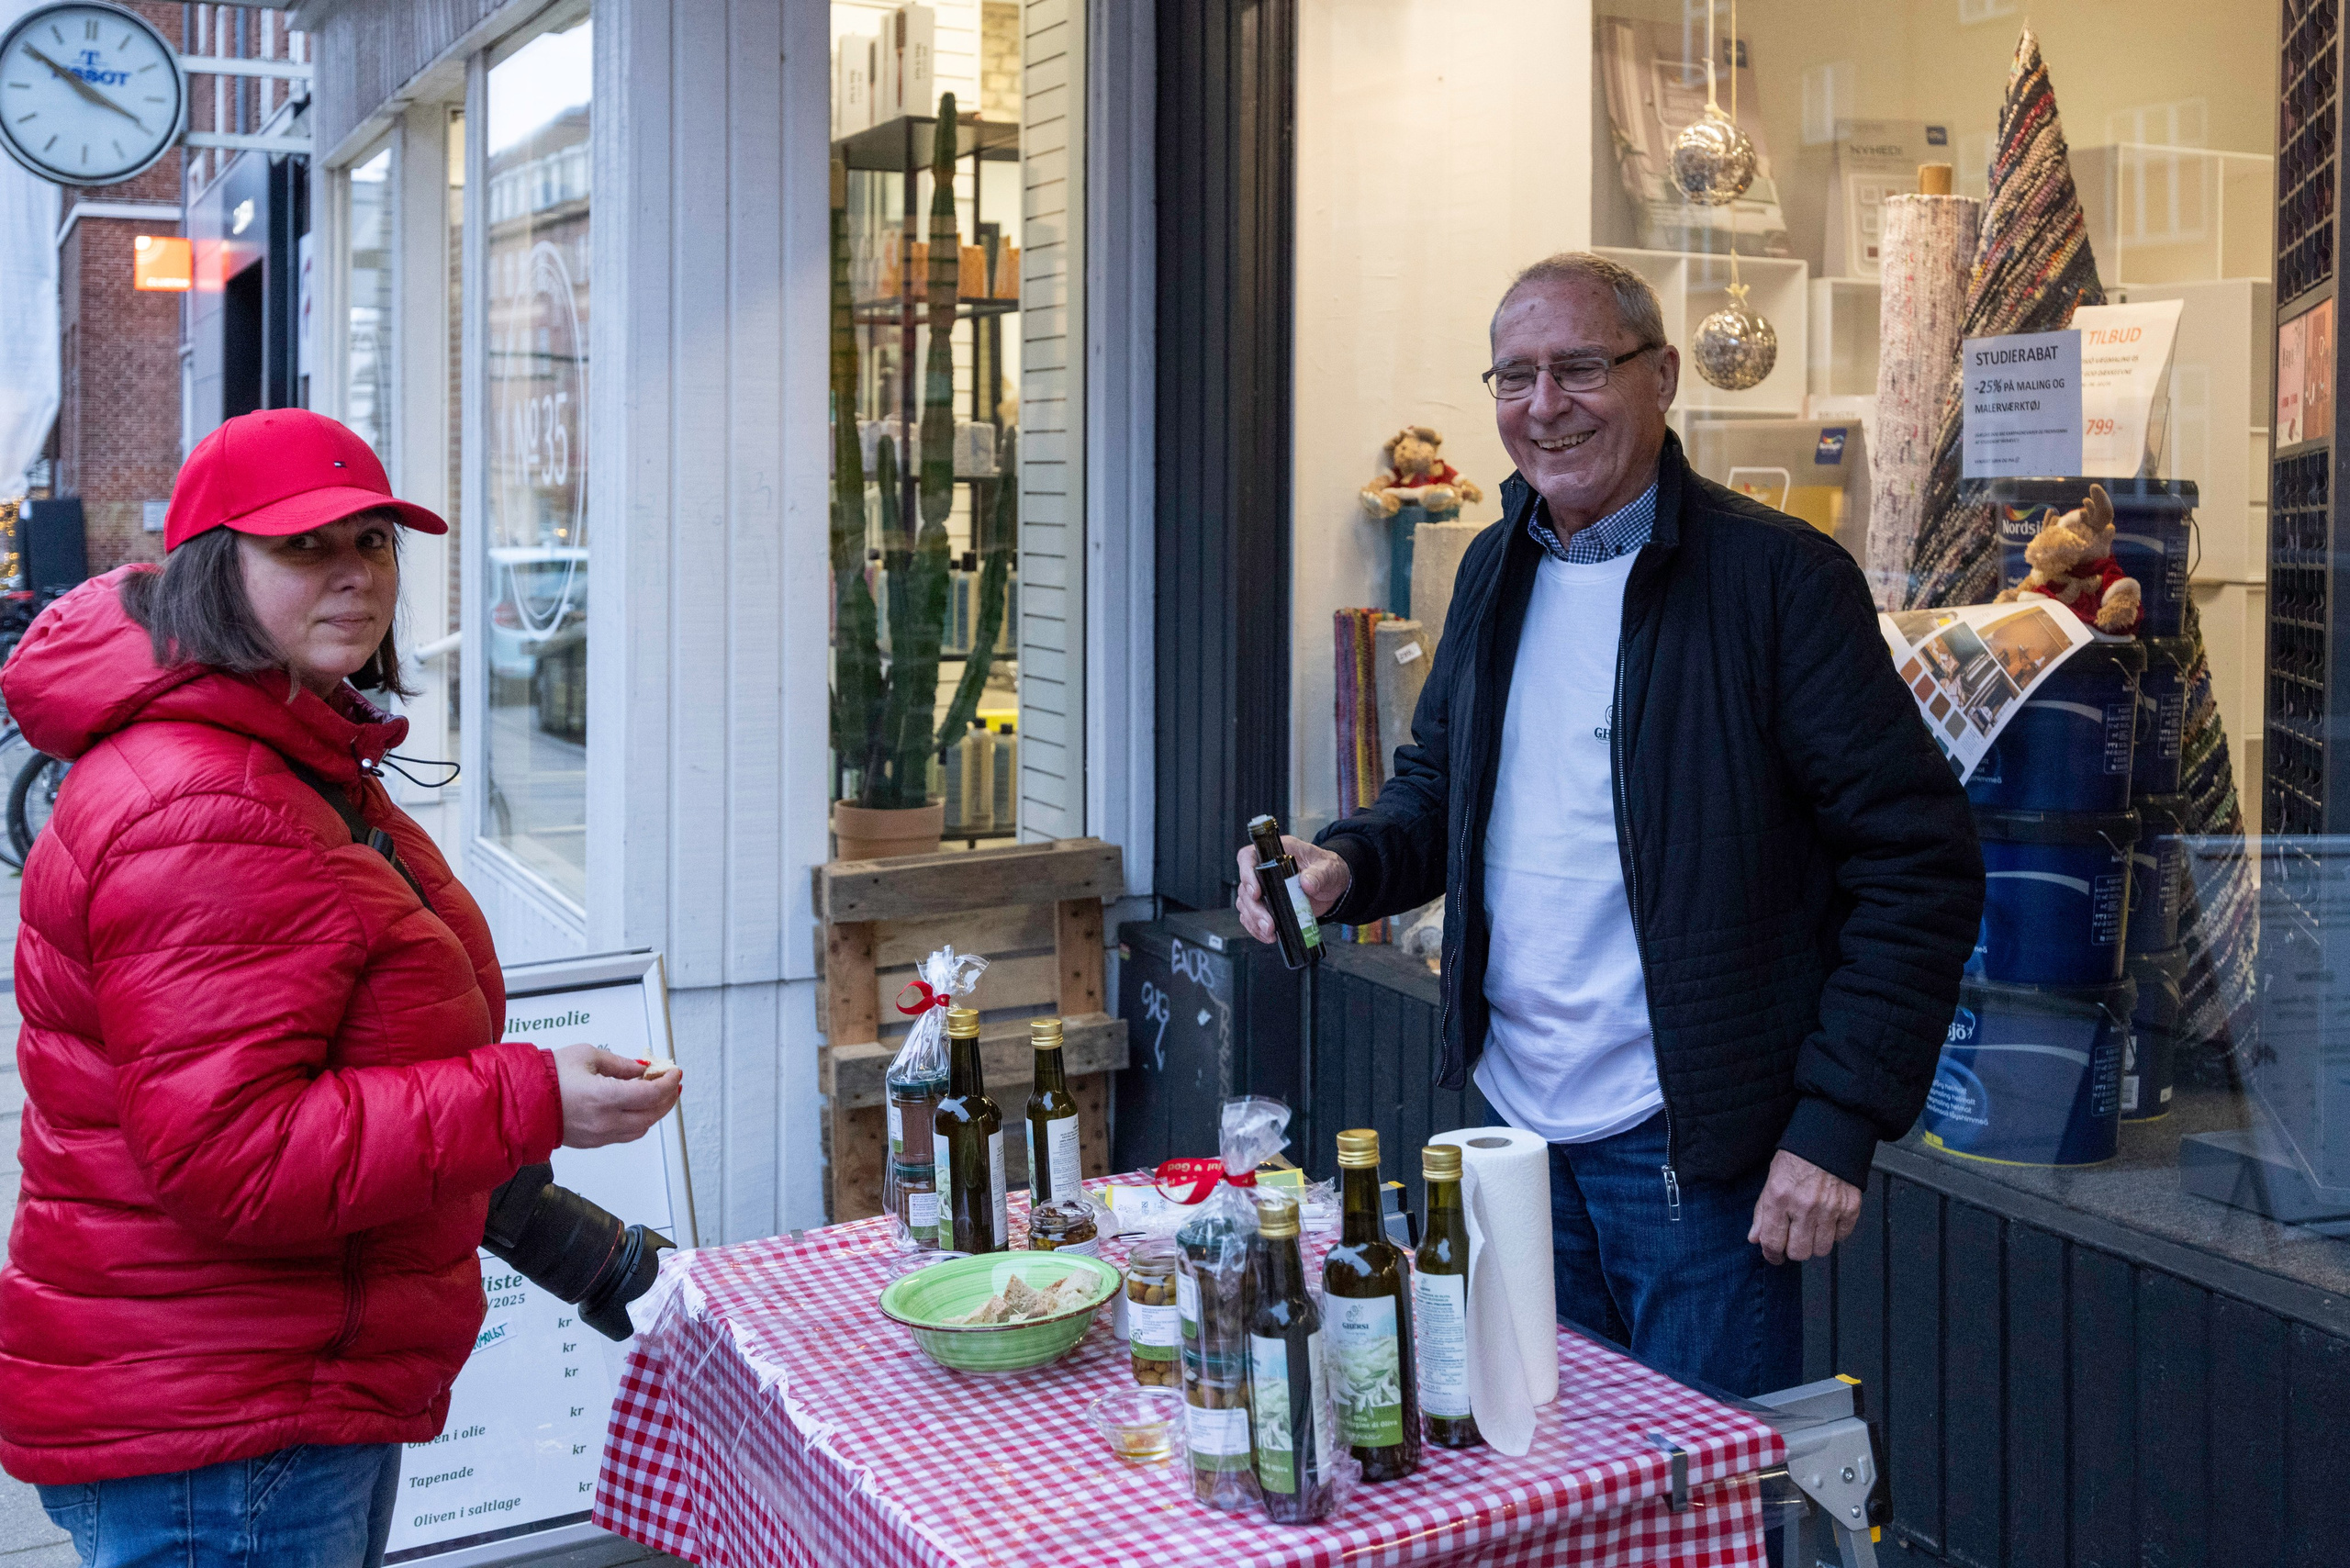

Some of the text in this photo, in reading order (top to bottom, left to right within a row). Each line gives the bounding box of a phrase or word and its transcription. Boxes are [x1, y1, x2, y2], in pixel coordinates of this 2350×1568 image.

[2088, 327, 2143, 346] TILBUD
[1975, 345, 2058, 366] STUDIERABAT
[1975, 377, 2065, 394] -25% PÅ MALING OG
[1975, 400, 2041, 414] MALERVÆRKTØJ
[557, 1317, 572, 1328] kr
[563, 1342, 576, 1353] kr
[565, 1367, 578, 1378] kr
[570, 1406, 584, 1417] kr
[453, 1429, 458, 1440] i
[462, 1426, 486, 1439] olie
[572, 1443, 586, 1455] kr
[409, 1467, 474, 1488] Tapenade
[578, 1481, 592, 1493] kr
[414, 1497, 521, 1528] Oliven i saltlage
